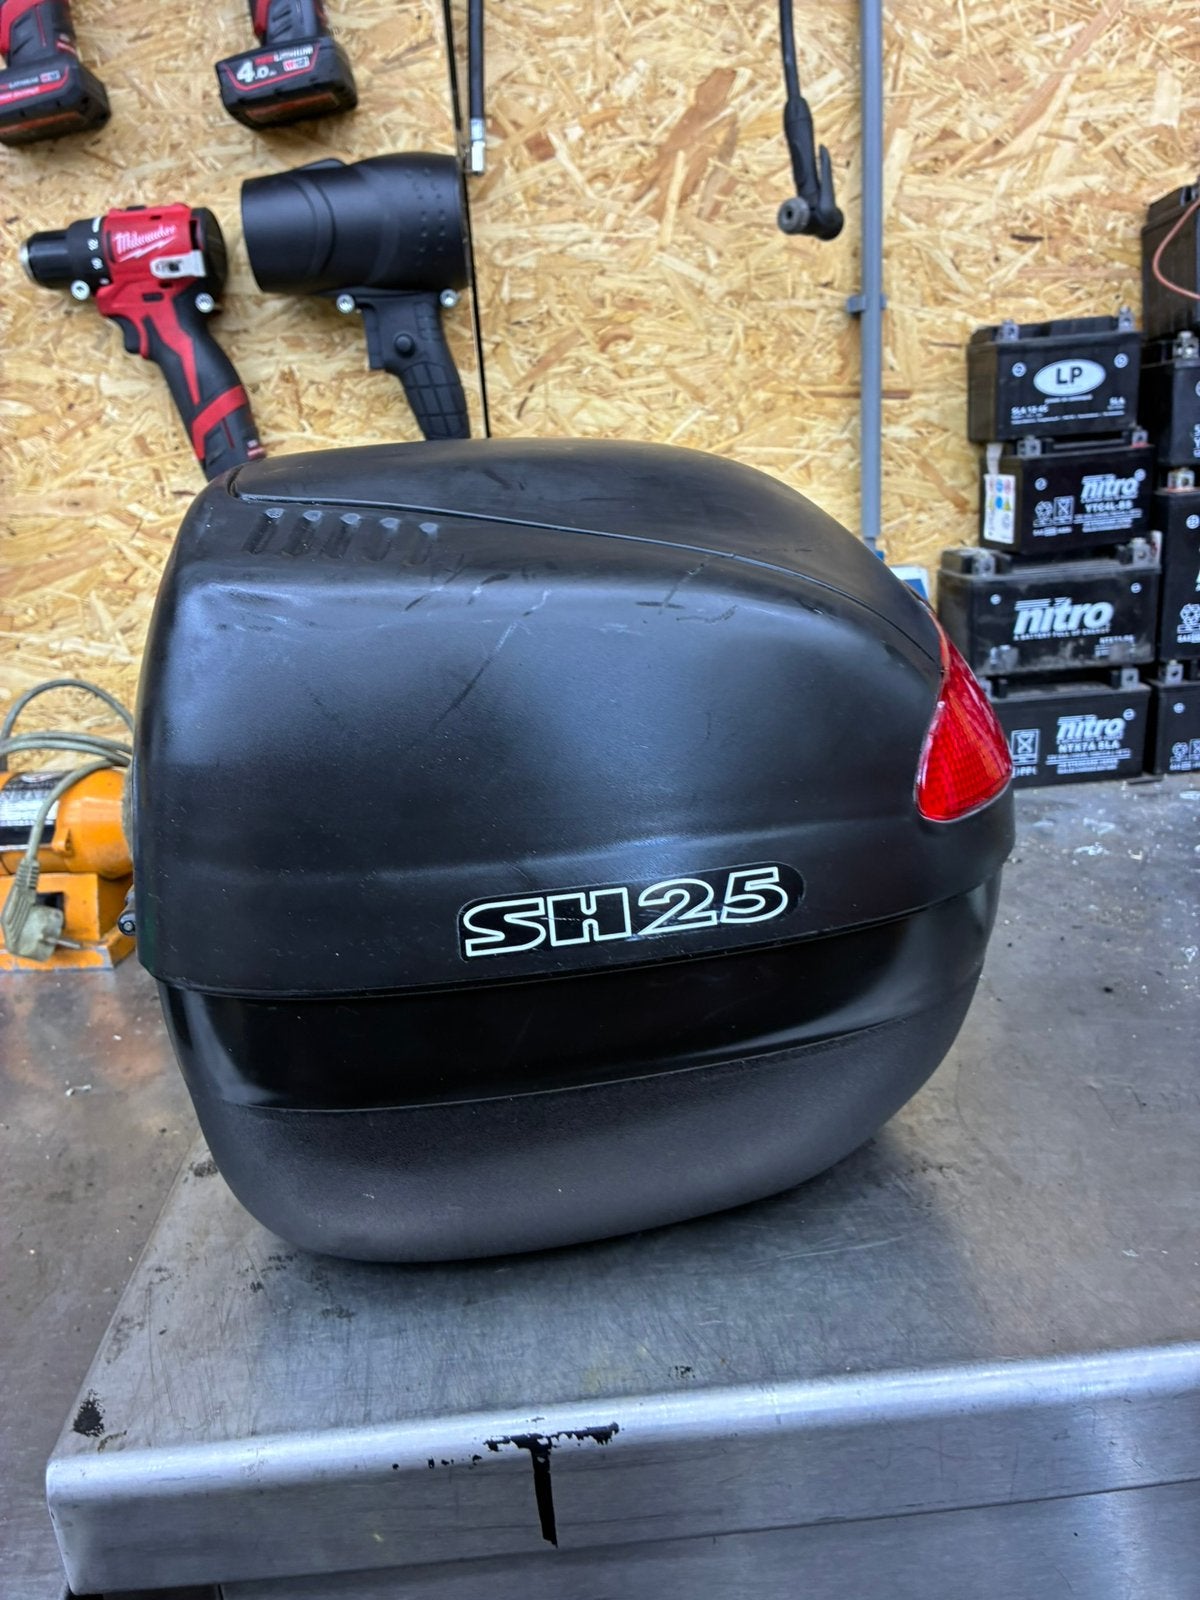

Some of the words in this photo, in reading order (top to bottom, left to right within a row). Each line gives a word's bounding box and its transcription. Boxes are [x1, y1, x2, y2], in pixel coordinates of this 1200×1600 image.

[114, 225, 177, 255] Milwaukee
[1056, 367, 1082, 385] LP
[1082, 474, 1139, 500] nitro
[1014, 597, 1114, 635] nitro
[1057, 715, 1125, 739] nitro
[463, 866, 789, 957] SH25
